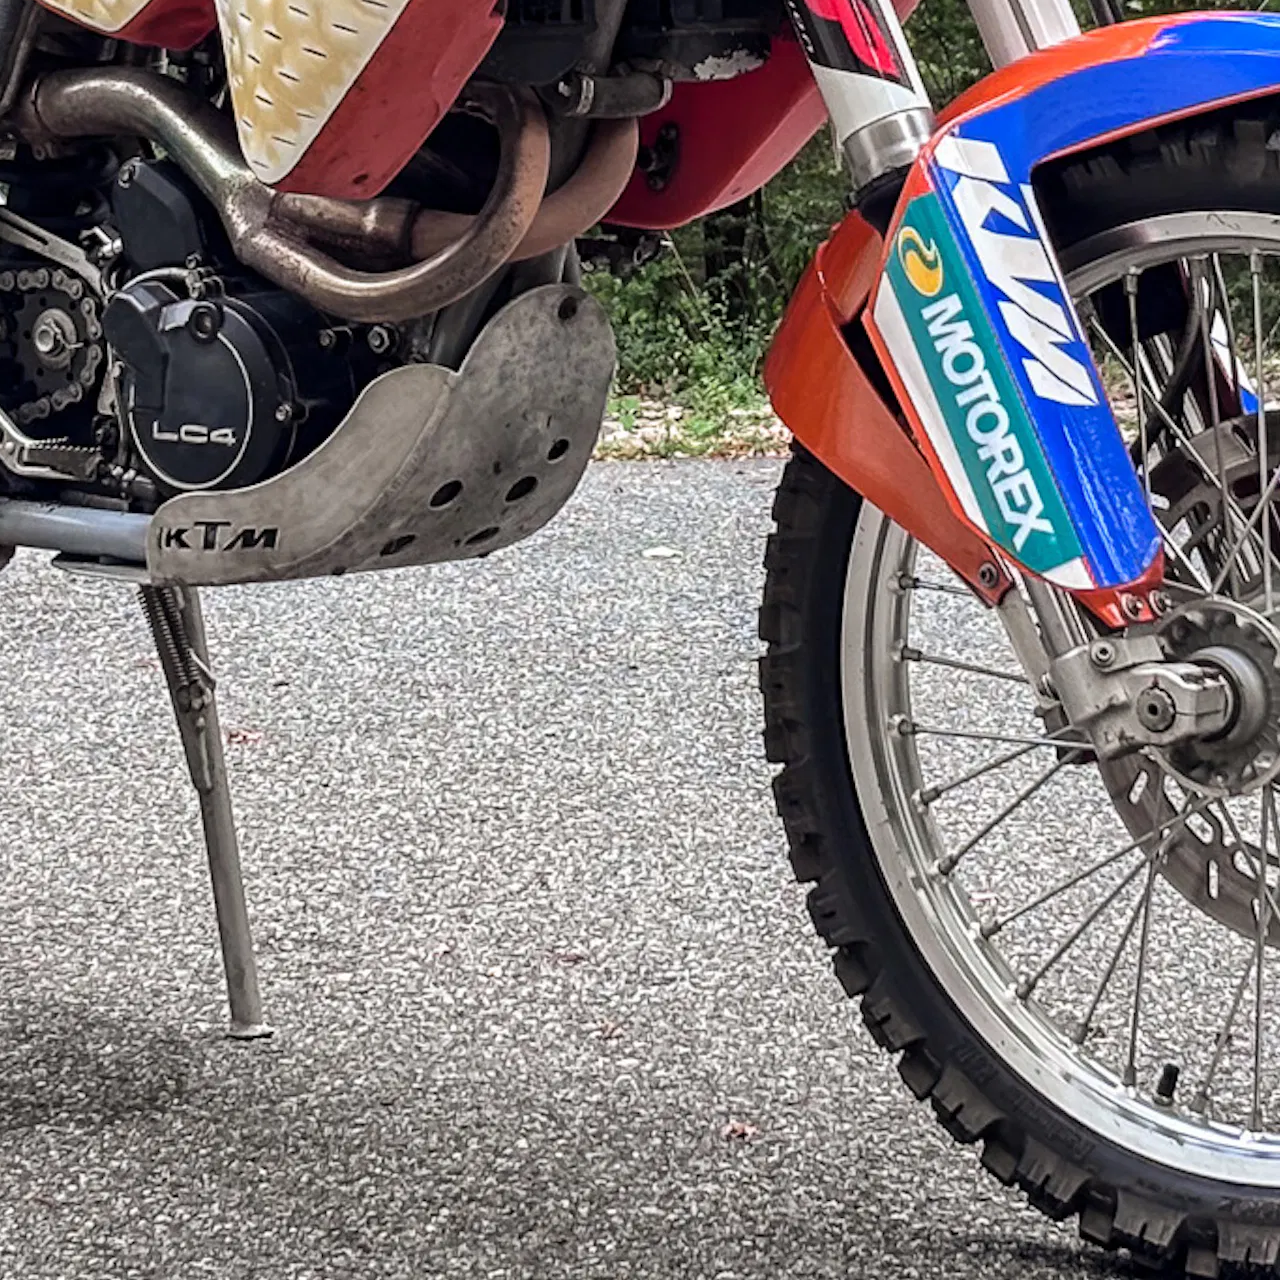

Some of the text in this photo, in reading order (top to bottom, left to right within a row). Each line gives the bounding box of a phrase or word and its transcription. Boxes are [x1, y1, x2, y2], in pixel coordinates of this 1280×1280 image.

[935, 136, 1100, 406] KTM
[152, 420, 236, 447] LC4
[920, 292, 1054, 552] MOTOREX
[159, 521, 279, 552] KTM
